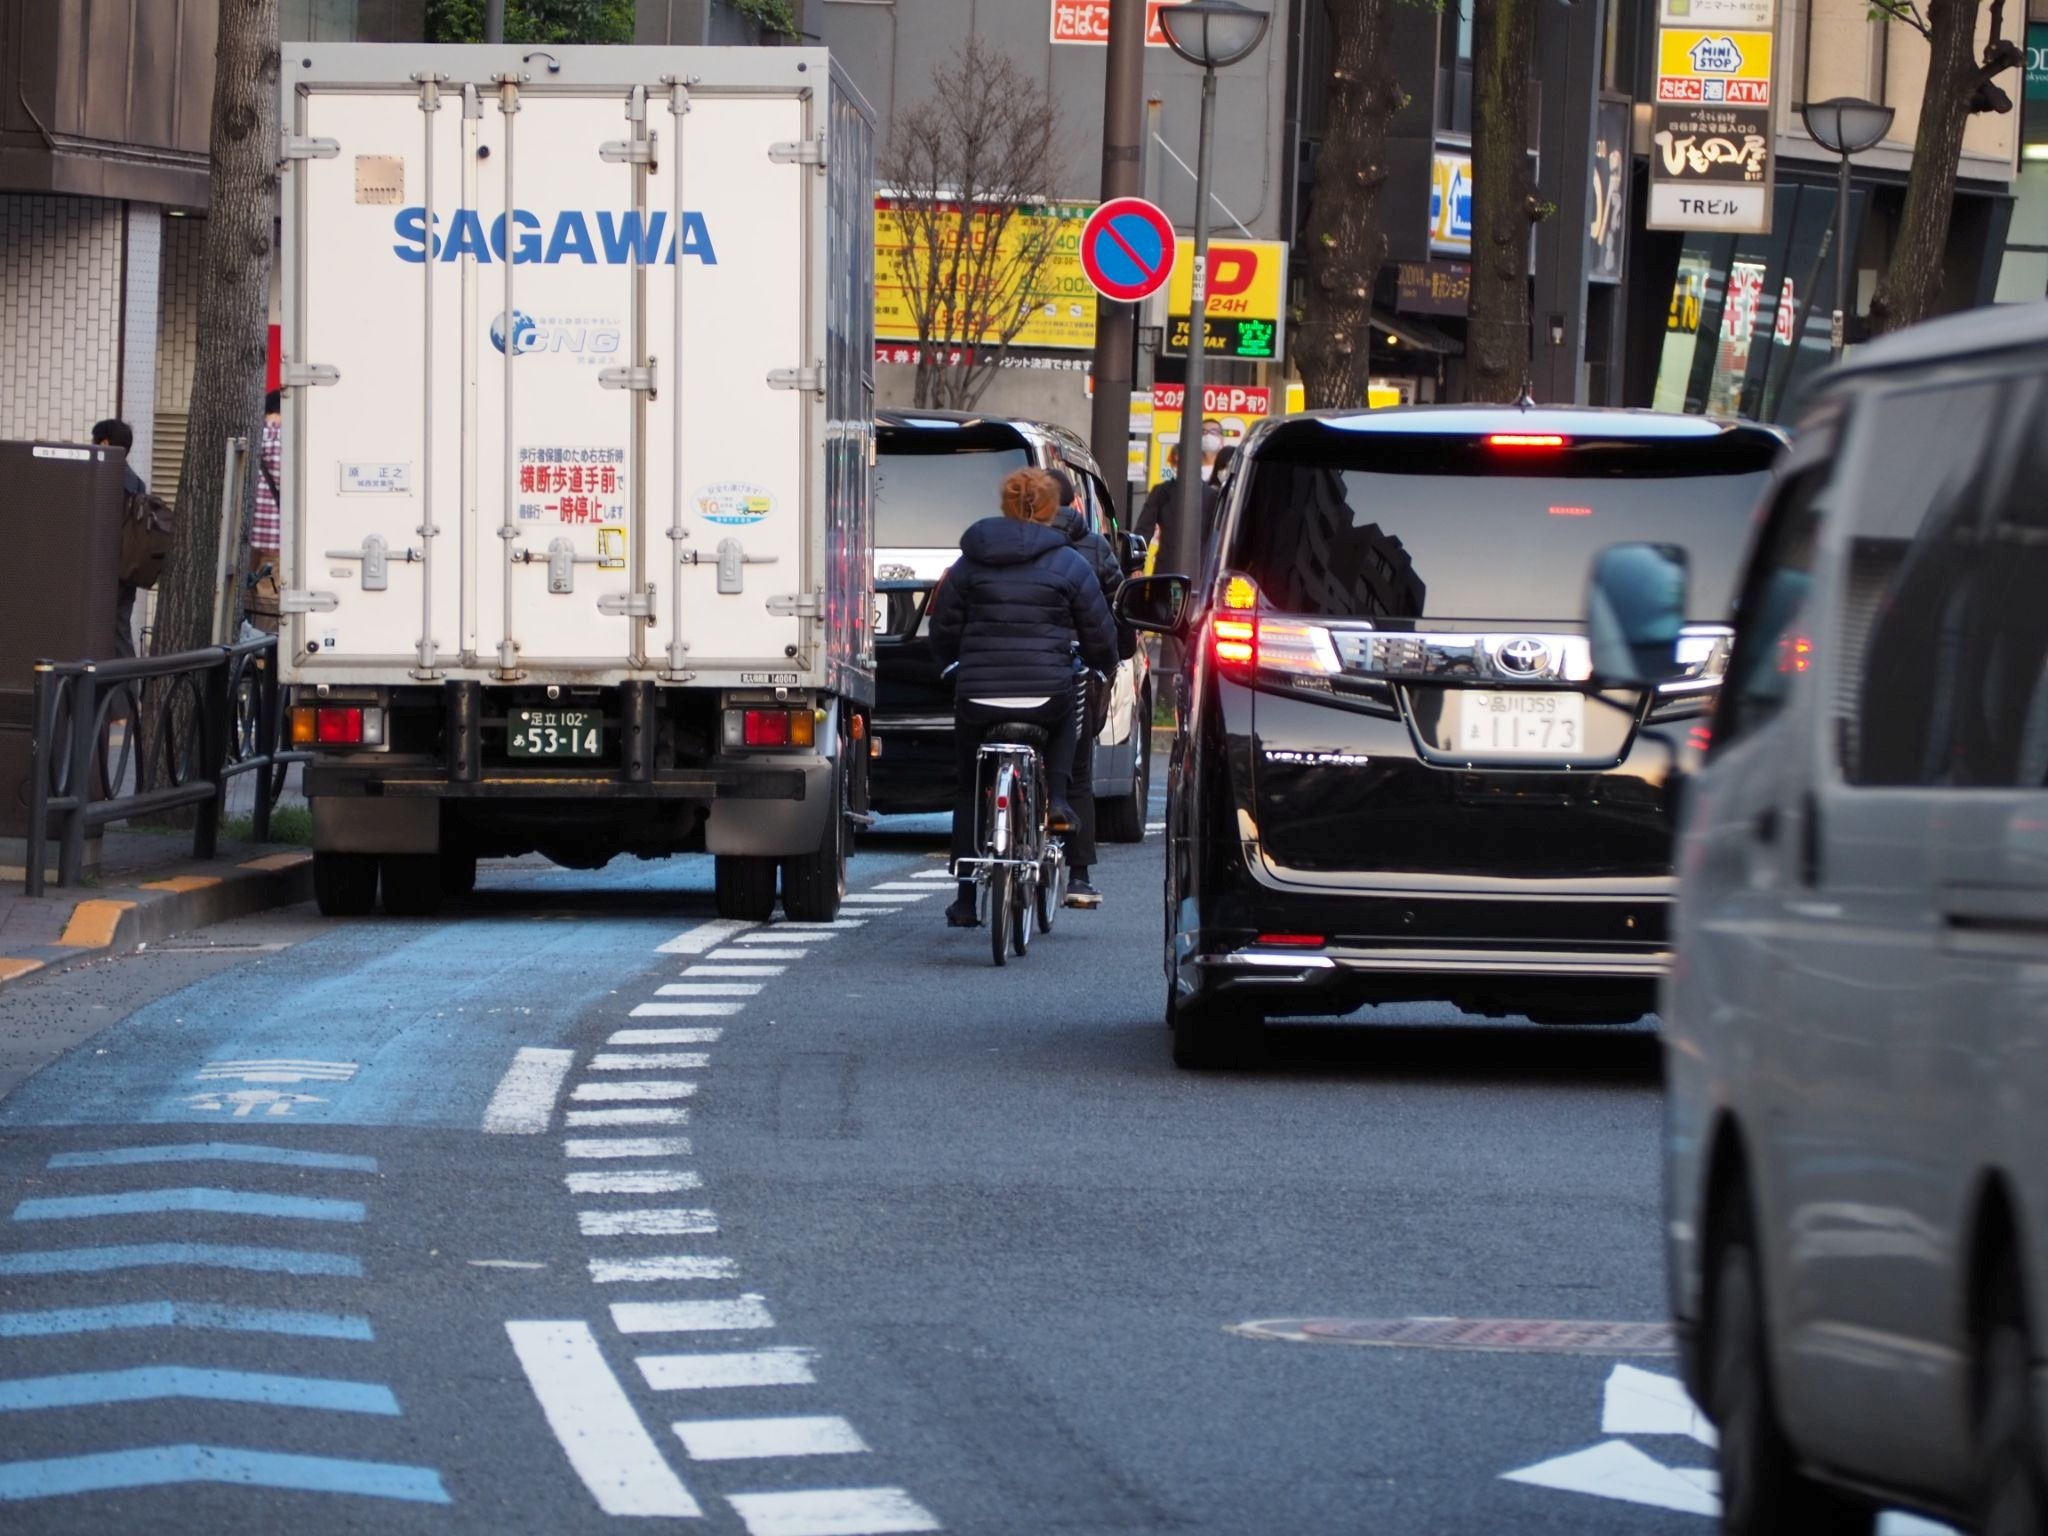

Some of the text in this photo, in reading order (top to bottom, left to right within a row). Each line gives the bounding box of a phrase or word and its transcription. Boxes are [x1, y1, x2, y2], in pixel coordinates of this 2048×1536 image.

[1057, 5, 1109, 36] たばこ
[1702, 46, 1731, 56] MINI
[1700, 58, 1732, 68] STOP
[1661, 79, 1768, 101] たばこ 酒 ATM
[1680, 199, 1738, 215] TRビル
[393, 206, 717, 266] SAGAWA
[1209, 298, 1248, 312] 24H
[1177, 321, 1211, 334] TOO
[517, 328, 620, 353] CNG
[520, 448, 624, 463] 歩行者保護のため右左折時
[520, 465, 624, 494] 横断歩道手前で
[528, 728, 598, 753] 53-14
